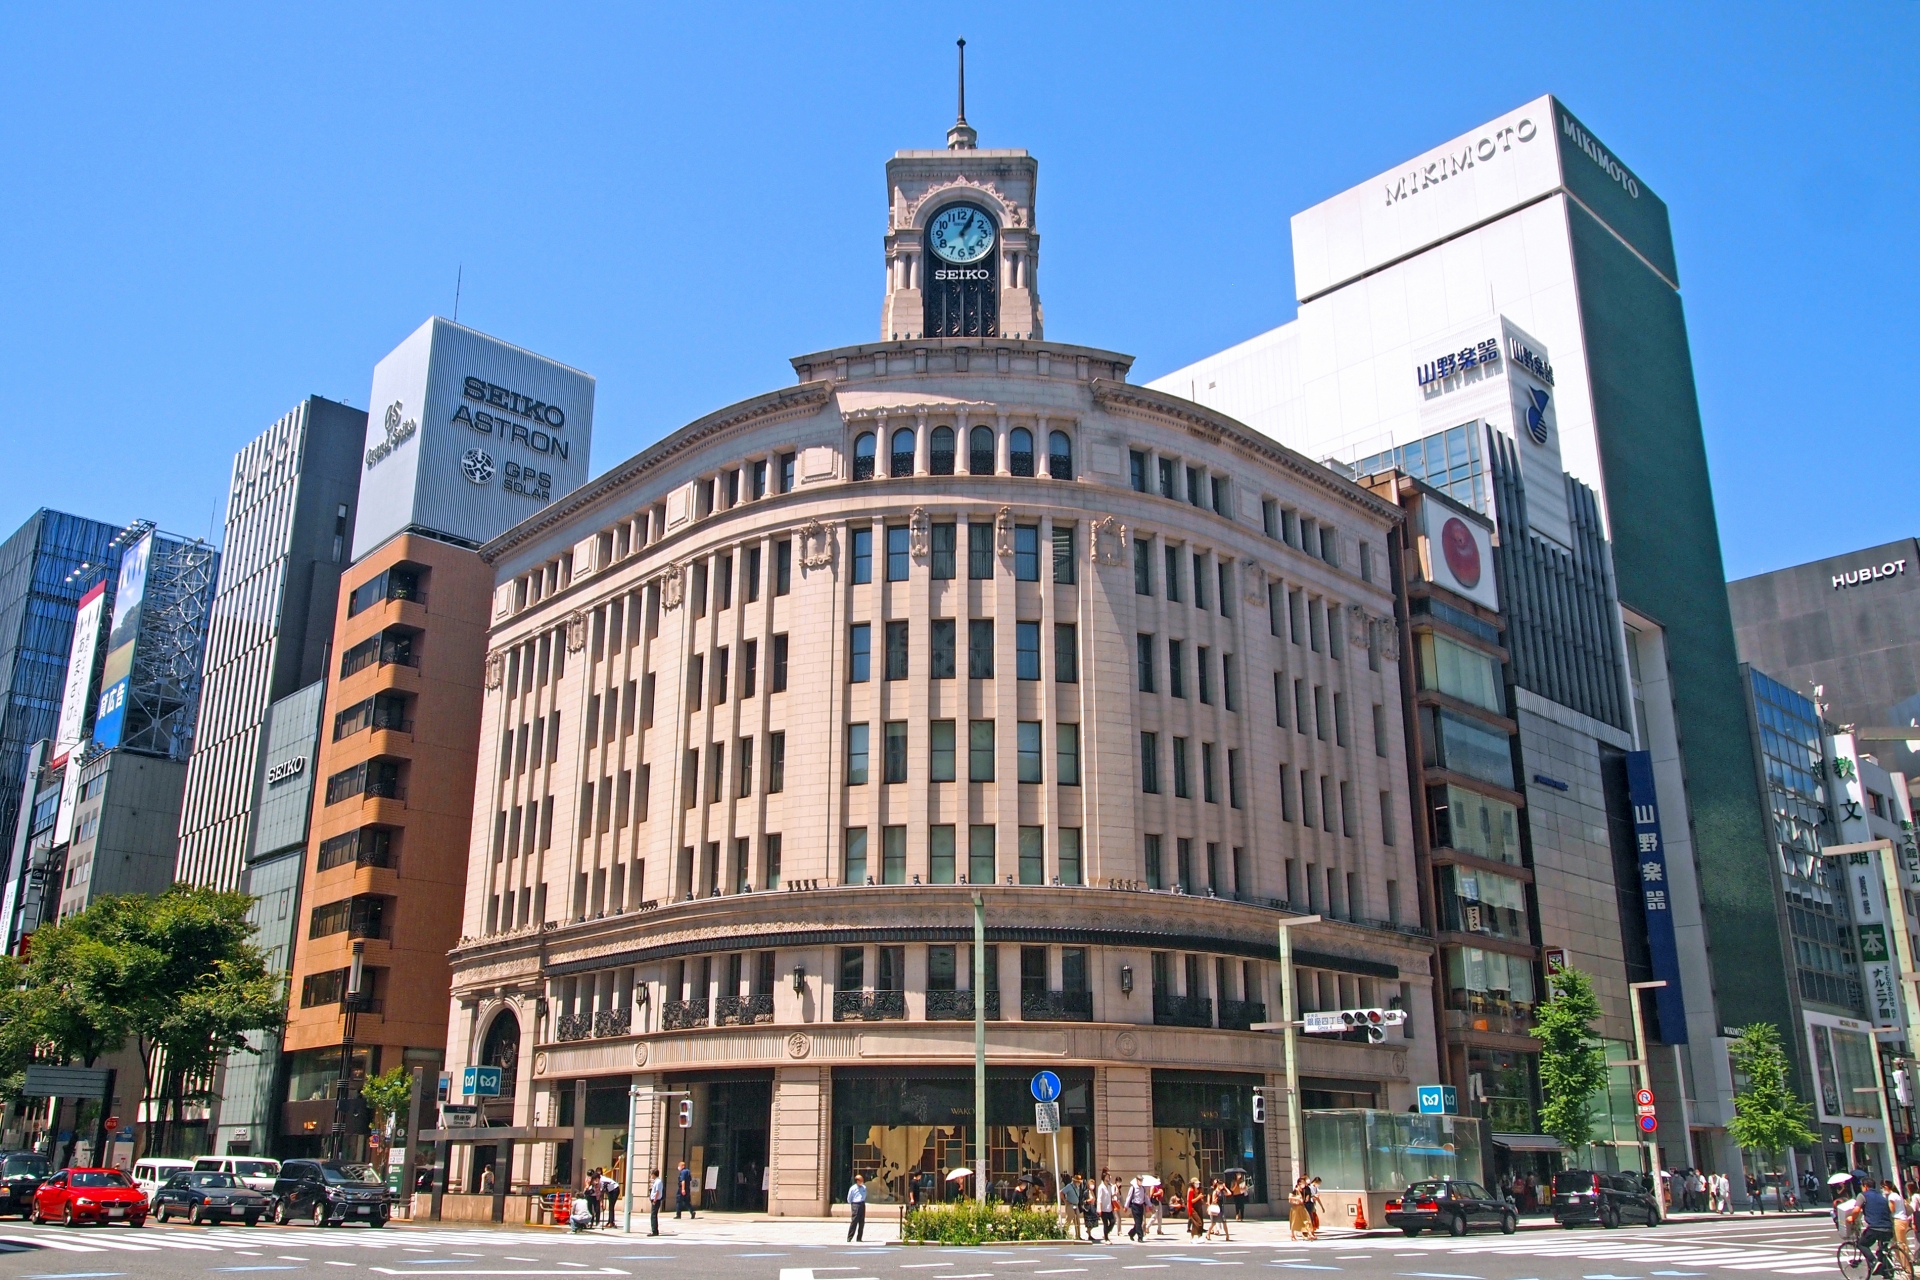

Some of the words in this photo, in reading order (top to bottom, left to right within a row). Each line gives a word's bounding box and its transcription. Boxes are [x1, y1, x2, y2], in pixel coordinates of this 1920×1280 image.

[1384, 117, 1537, 206] MIKIMOTO
[1562, 114, 1639, 200] MIKIMOTO
[939, 220, 948, 229] 10
[948, 213, 956, 222] 11
[957, 211, 967, 220] 12
[977, 220, 984, 229] 2
[936, 230, 943, 239] 9
[940, 240, 947, 248] 8
[976, 239, 984, 248] 4
[980, 230, 988, 238] 3
[948, 246, 956, 255] 7
[958, 248, 965, 258] 6
[968, 246, 976, 255] 5
[935, 269, 989, 280] SEIKO
[1417, 338, 1498, 387] 山野楽器
[1510, 336, 1555, 387] 山野楽器
[462, 375, 565, 428] SEIKO
[365, 434, 391, 466] Grand
[391, 418, 417, 446] Seiko
[452, 405, 568, 460] ASTRON
[504, 460, 552, 489] GPS
[502, 479, 550, 501] SOLAR
[1832, 559, 1907, 588] HUBLOT
[97, 682, 126, 721] 貸広告
[267, 755, 305, 784] SEIKO
[1634, 804, 1666, 911] 山野楽器
[1861, 930, 1885, 957] 本
[950, 1107, 976, 1116] WAKO
